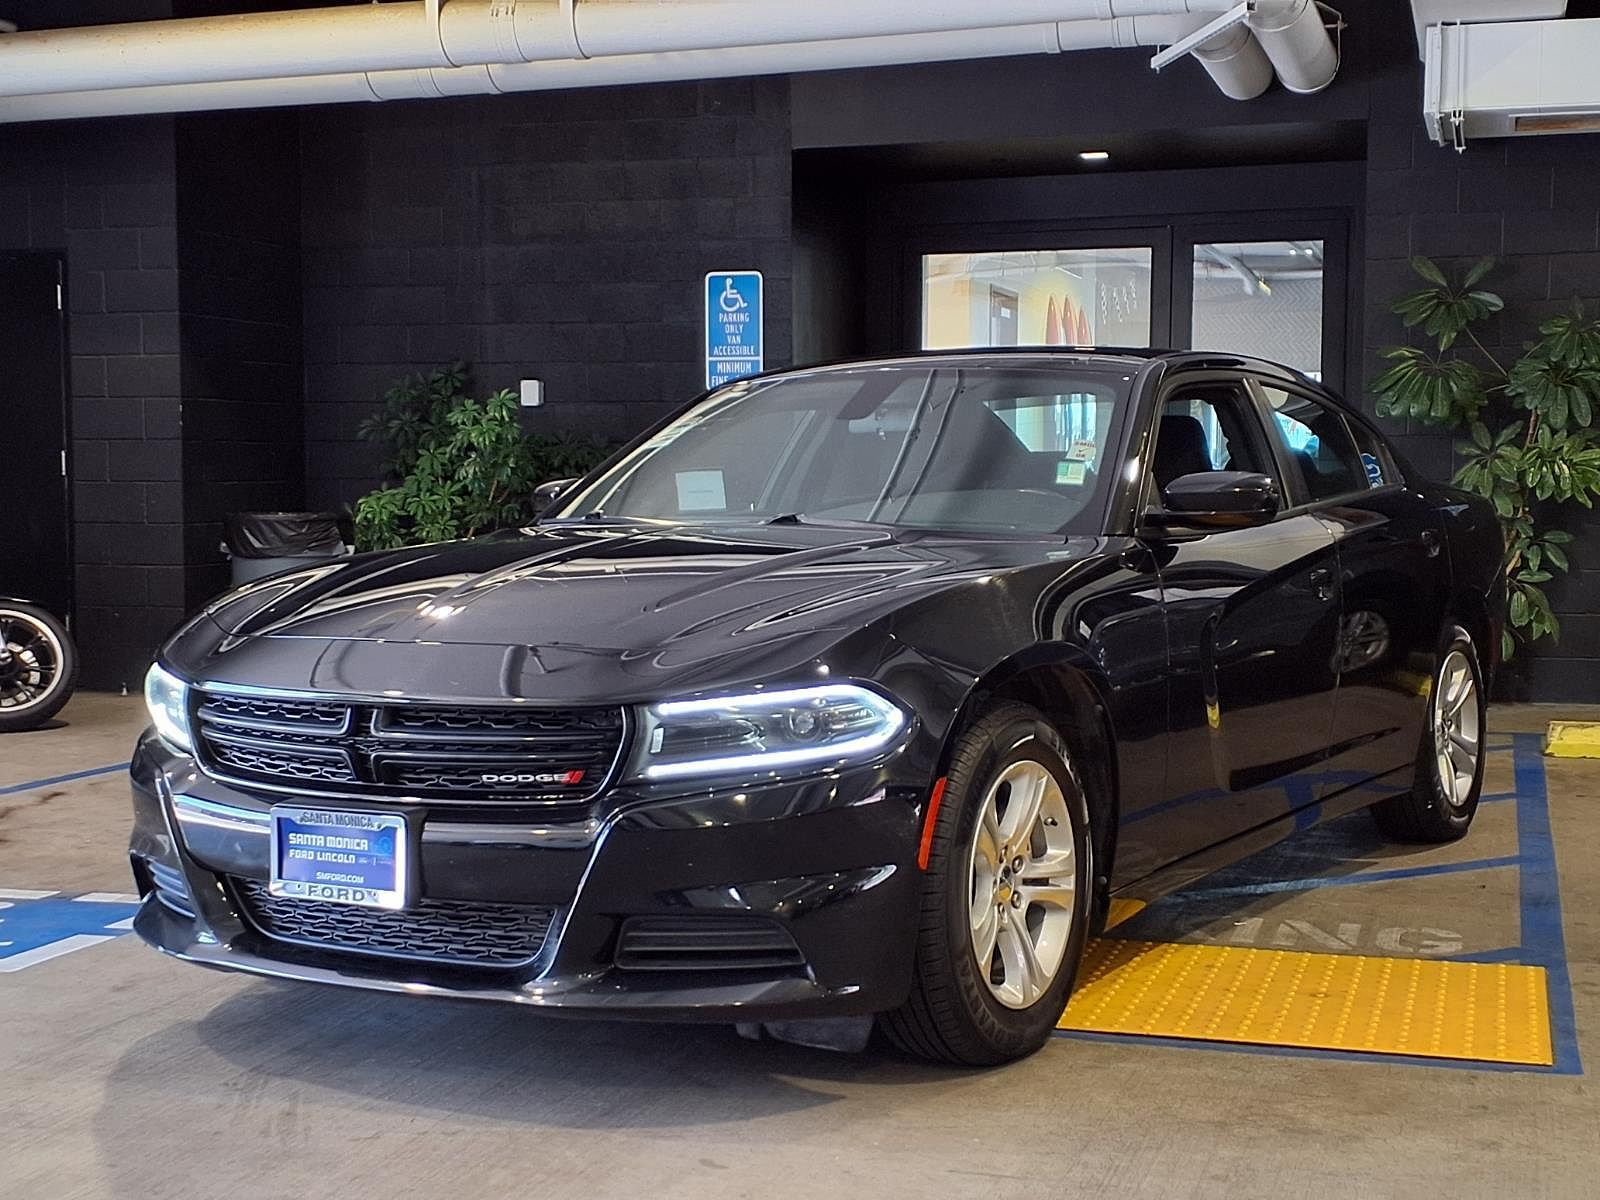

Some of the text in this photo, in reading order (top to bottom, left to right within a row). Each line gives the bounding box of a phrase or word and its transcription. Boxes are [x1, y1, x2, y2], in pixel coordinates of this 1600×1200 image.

[719, 312, 750, 323] PARKING
[724, 323, 744, 334] ONLY
[727, 335, 741, 345] VAN
[713, 345, 755, 356] ACCESSIBLE
[716, 361, 752, 374] MINIMUM
[481, 774, 570, 783] DODGE
[301, 811, 375, 829] SANTA MONICA
[288, 832, 369, 851] SANTA MONICA
[288, 848, 315, 860] FORD
[316, 851, 356, 864] LINCOLN
[307, 884, 366, 902] FORD
